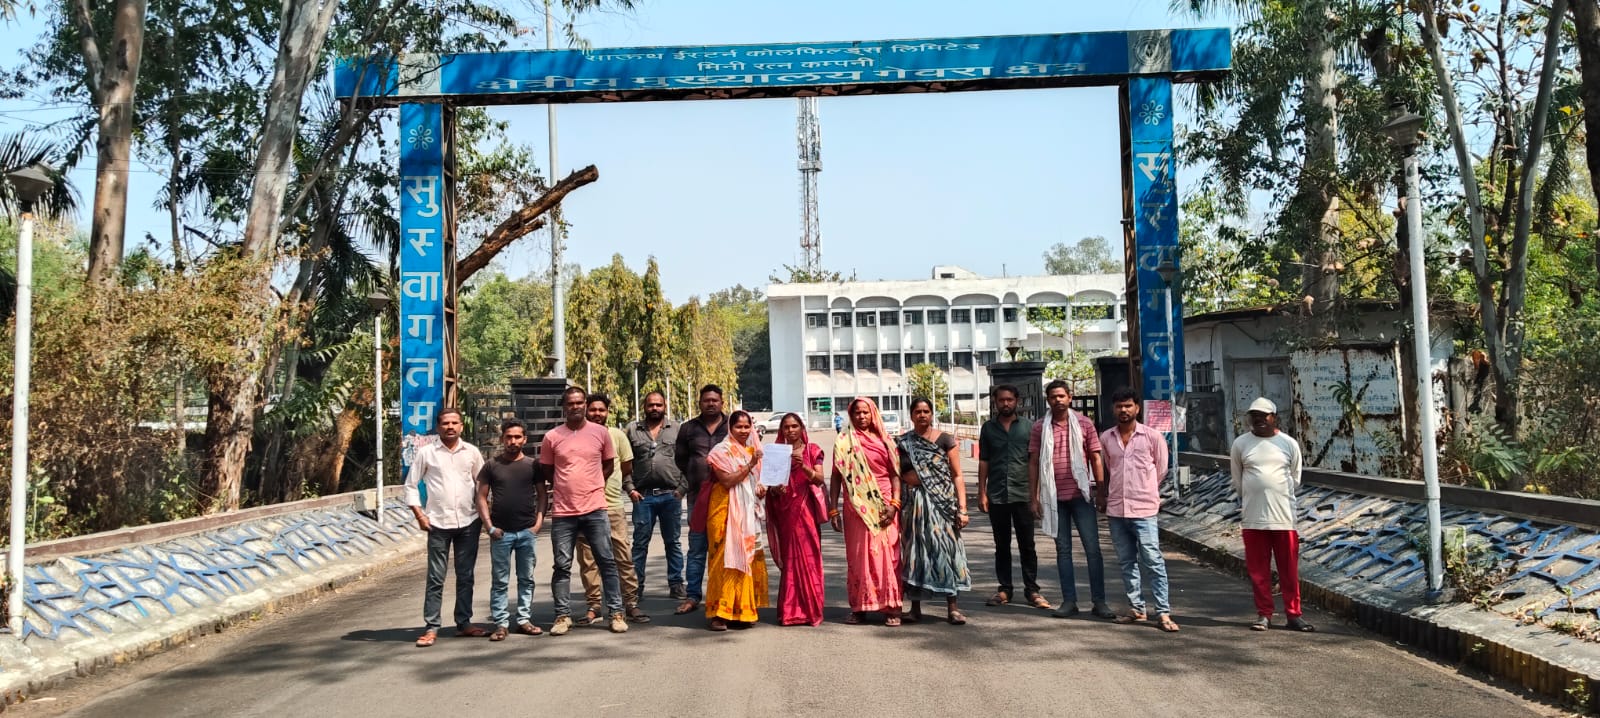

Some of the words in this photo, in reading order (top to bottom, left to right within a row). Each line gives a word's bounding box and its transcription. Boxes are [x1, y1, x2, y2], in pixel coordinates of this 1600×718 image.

[890, 42, 980, 54] लिमिटेड
[697, 61, 745, 72] मिनी
[753, 62, 793, 71] रत्न
[801, 57, 875, 69] कम्पनी
[476, 75, 622, 90] क्षेत्रीय
[632, 70, 864, 88] मुख्यालय
[873, 65, 995, 80] गेवरा
[1005, 61, 1089, 74] क्षेत्र
